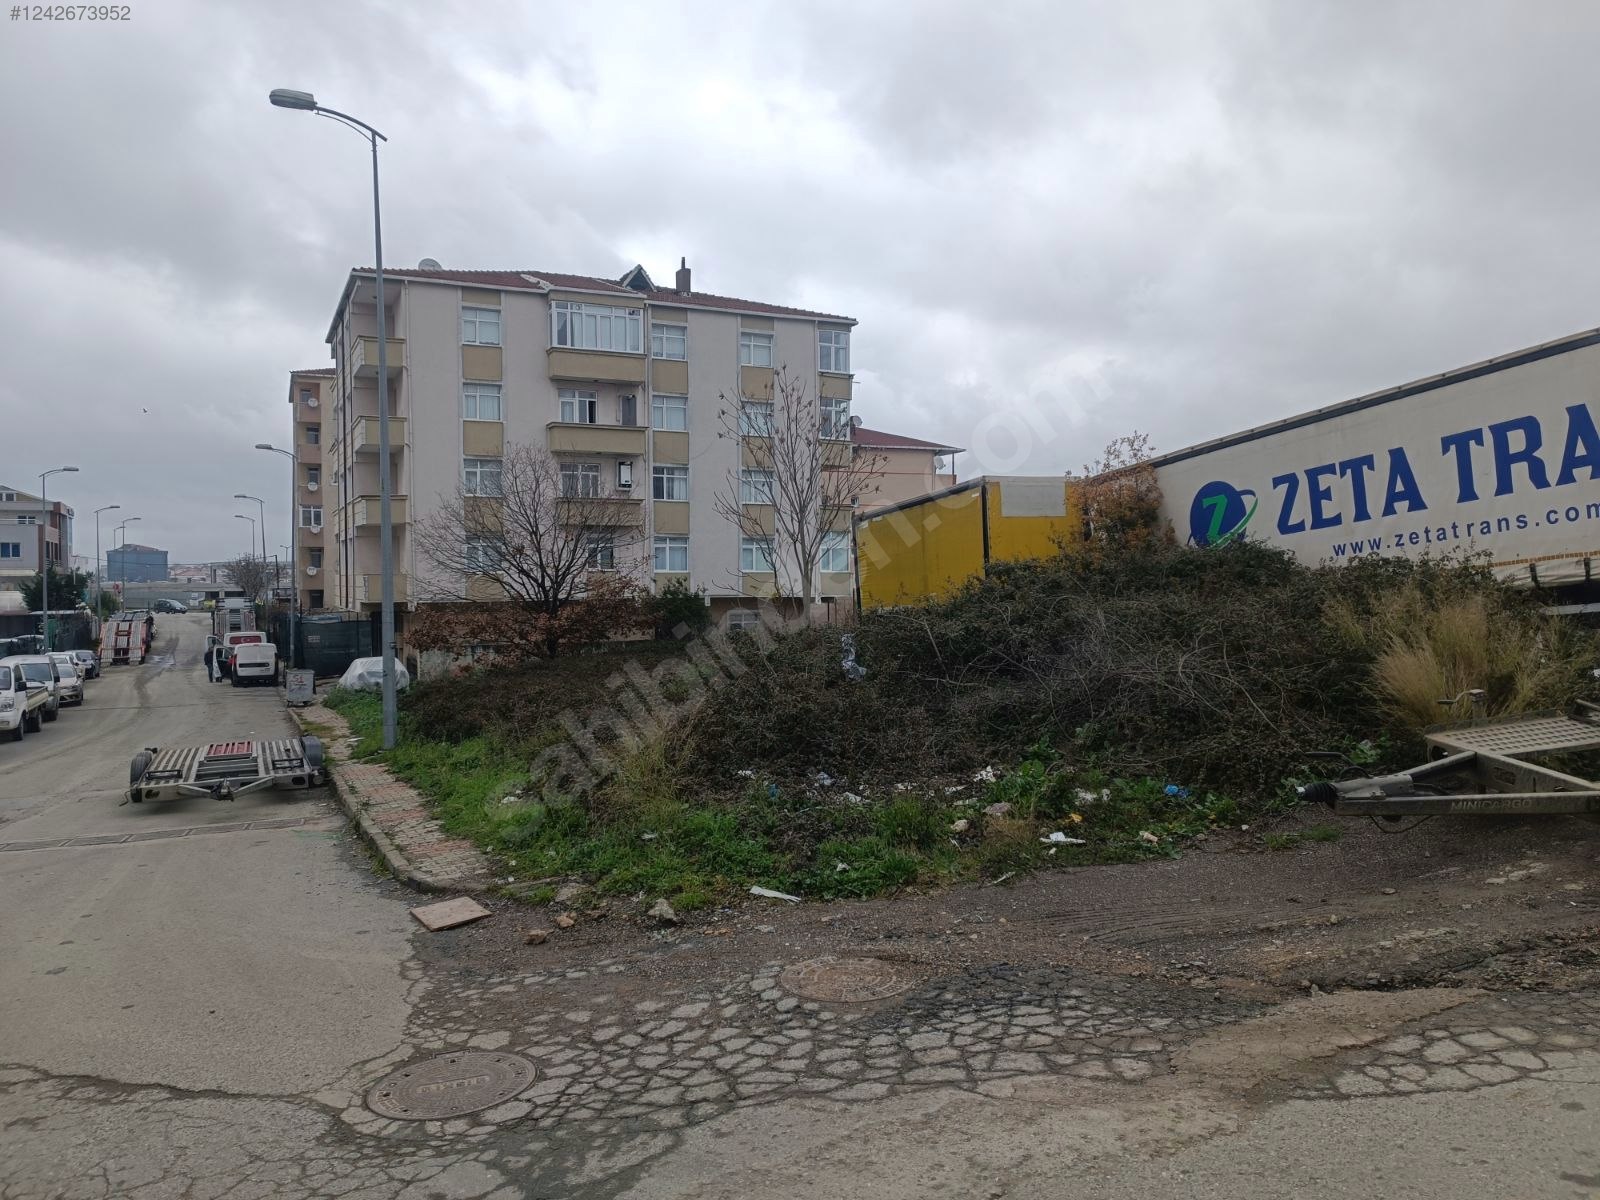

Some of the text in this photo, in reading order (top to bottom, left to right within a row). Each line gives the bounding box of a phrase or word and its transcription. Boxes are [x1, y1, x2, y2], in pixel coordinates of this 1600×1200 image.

[1272, 447, 1428, 535] ZETA
[1333, 502, 1600, 557] www.zetatrans.com
[1450, 799, 1532, 811] MINICARGO
